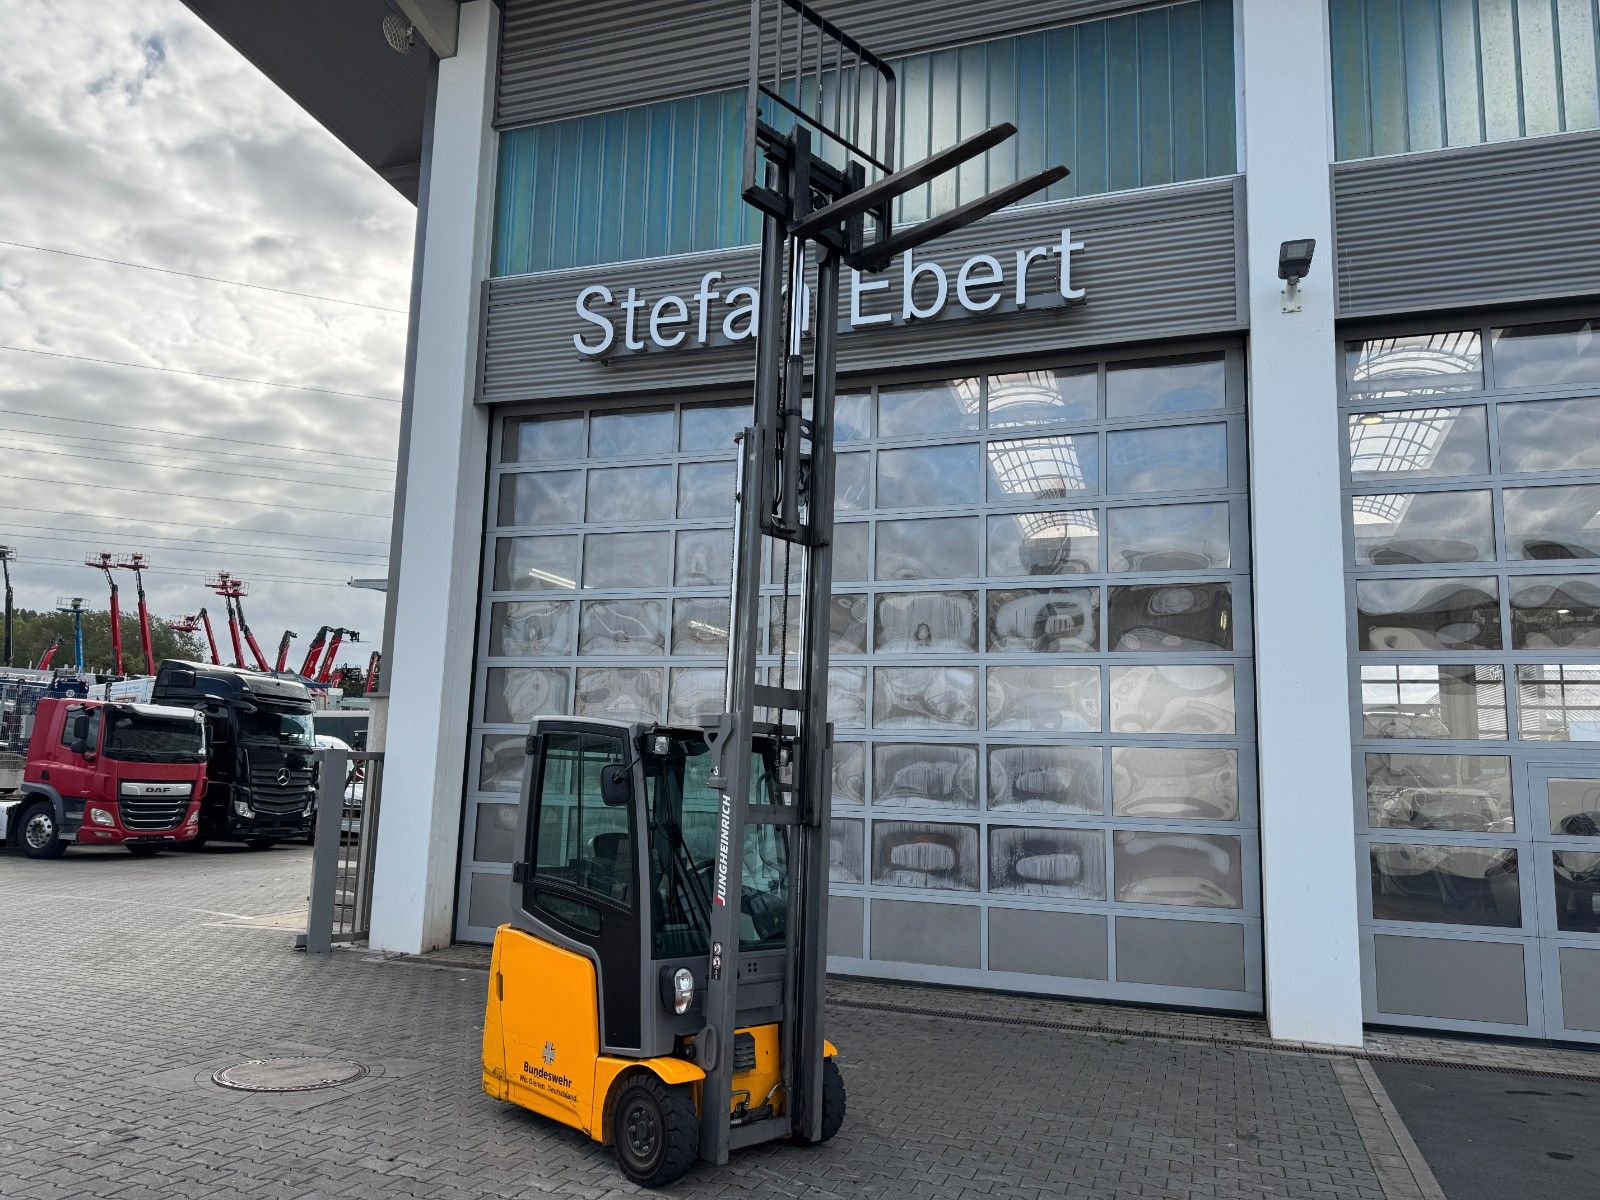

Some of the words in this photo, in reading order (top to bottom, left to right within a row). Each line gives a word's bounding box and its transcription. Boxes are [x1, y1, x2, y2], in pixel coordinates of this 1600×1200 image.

[850, 228, 1086, 326] Ebert
[715, 794, 731, 906] JUNGHEINRICH
[523, 1061, 573, 1088] Bundeswehr
